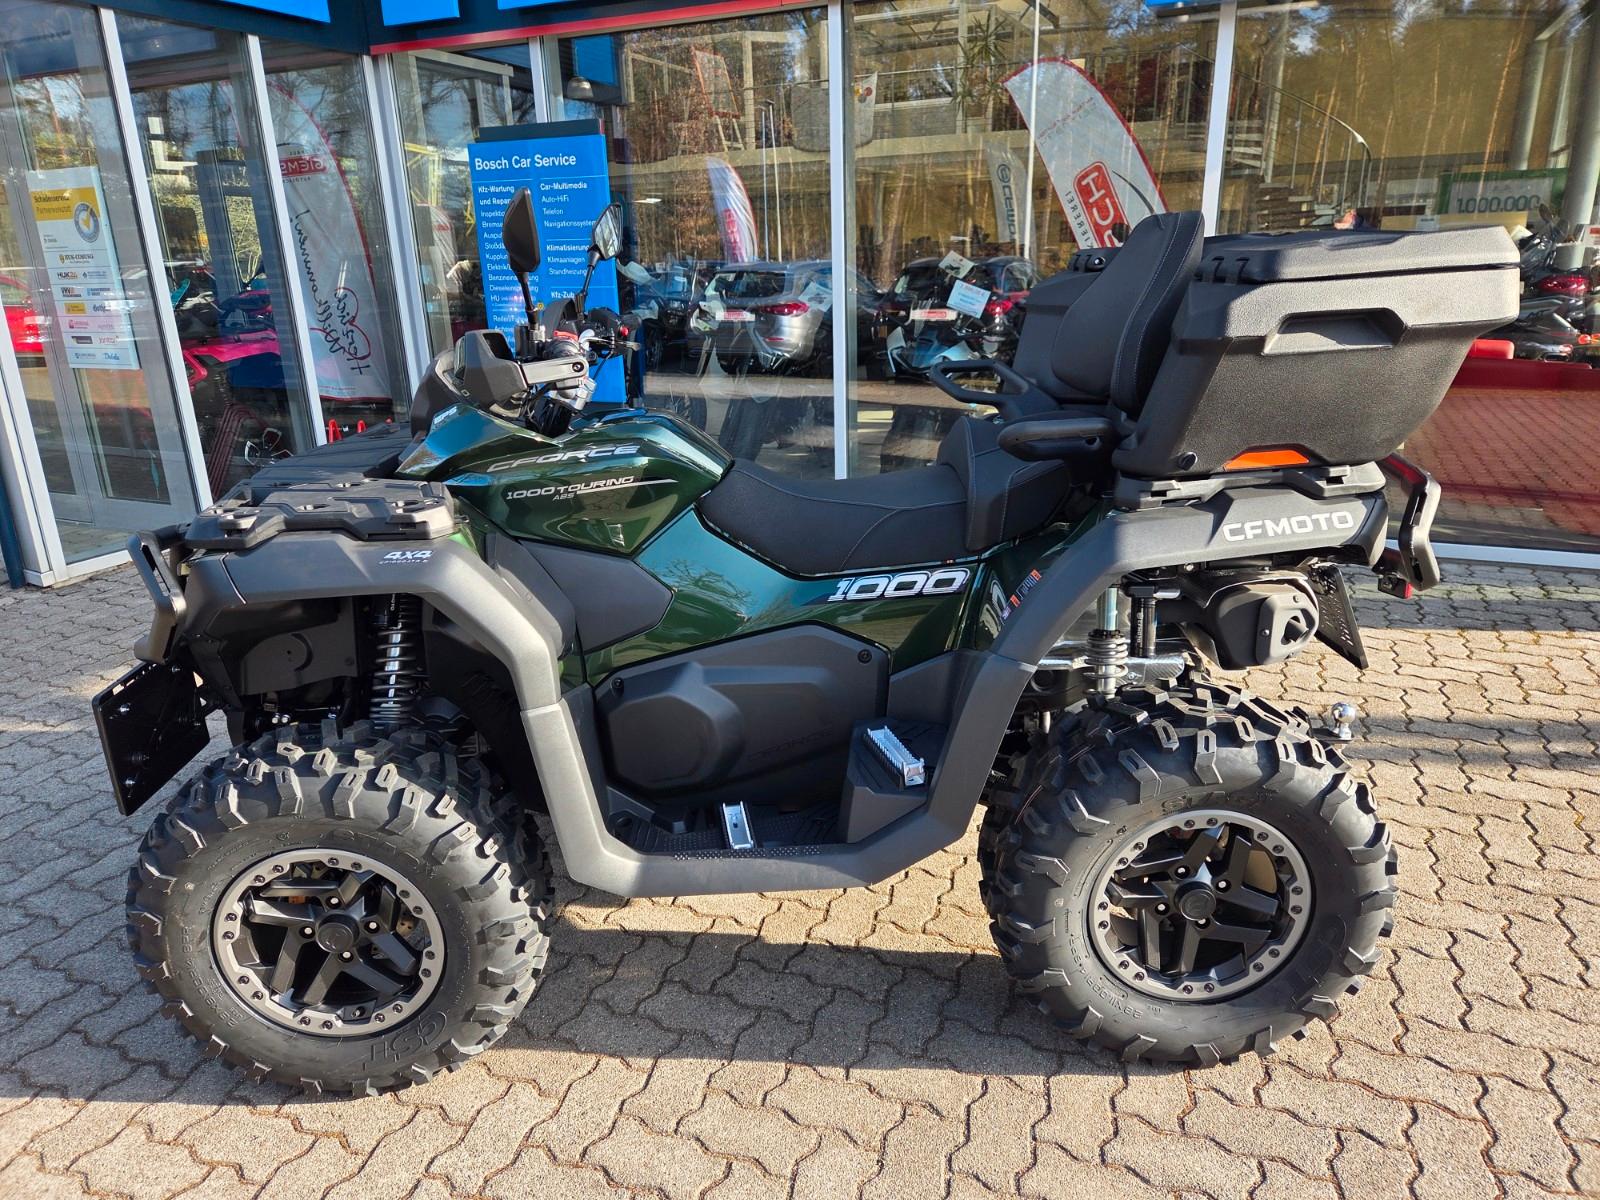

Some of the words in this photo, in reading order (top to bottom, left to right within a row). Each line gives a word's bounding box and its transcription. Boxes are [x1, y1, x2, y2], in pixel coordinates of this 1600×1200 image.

[474, 157, 509, 171] Bosch
[511, 155, 531, 169] Car
[534, 153, 577, 168] Service
[478, 185, 515, 195] Kfz-Wartung
[539, 182, 588, 191] Car-Multimedia
[480, 198, 491, 206] und
[492, 197, 512, 206] Repar
[541, 194, 569, 203] Auto-HiFi
[542, 207, 564, 215] Telefon
[485, 253, 508, 261] Kupplun
[547, 256, 585, 265] Klimaanlagen
[551, 290, 576, 300] Kfz-Zub
[487, 445, 641, 472] CFORCE
[506, 486, 556, 500] 1000
[557, 476, 635, 494] TOURING
[552, 493, 576, 501] ABS
[1222, 511, 1354, 542] CFMOTO
[827, 568, 971, 602] 1000
